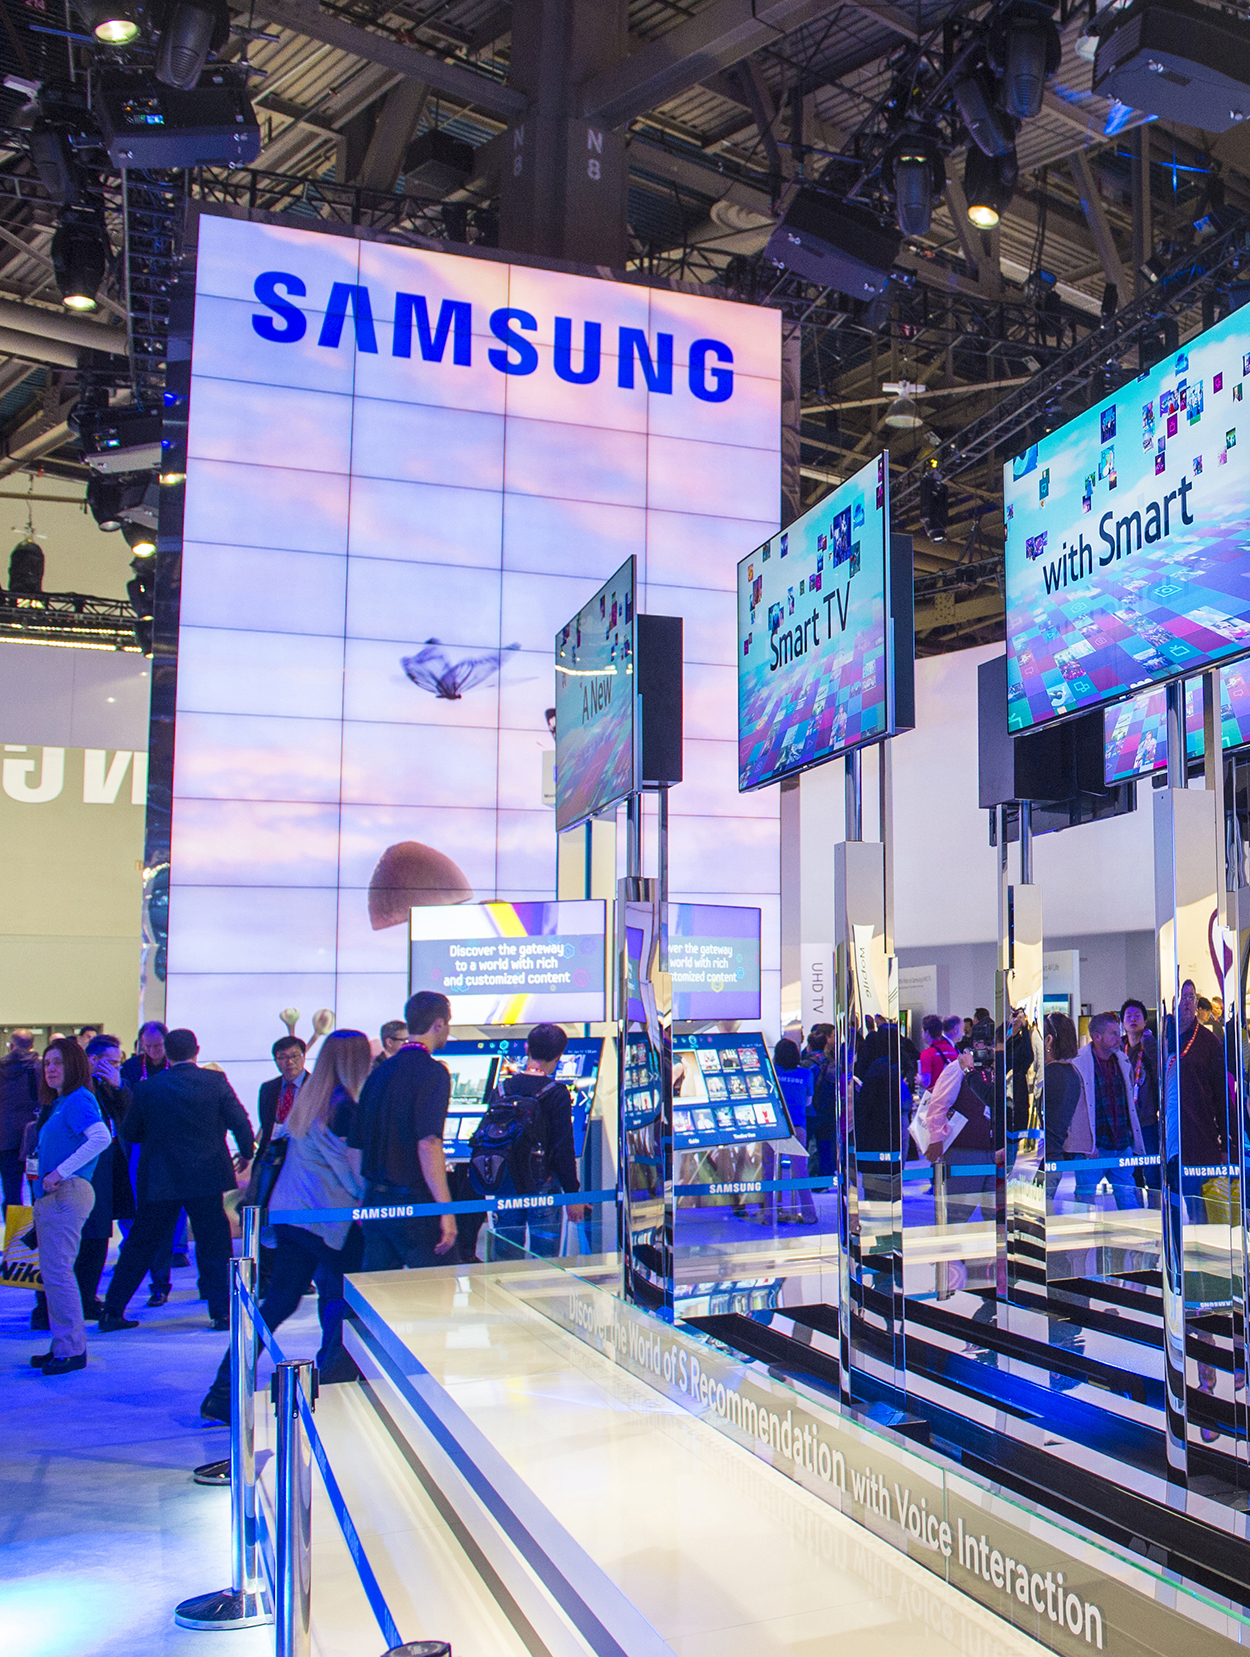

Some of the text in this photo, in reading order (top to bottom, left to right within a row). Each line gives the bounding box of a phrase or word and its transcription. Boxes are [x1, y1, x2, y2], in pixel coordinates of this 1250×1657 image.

[252, 270, 735, 404] SAMSUNG
[1042, 475, 1195, 596] with Smart
[769, 580, 851, 673] Smart TV
[591, 673, 613, 718] New
[449, 943, 565, 958] Discover the gateway
[684, 942, 699, 954] the
[701, 944, 733, 958] gateway
[455, 956, 558, 972] to a world with rich
[694, 957, 711, 969] with
[713, 957, 729, 969] rich
[443, 971, 571, 987] and customized content
[672, 971, 738, 983] stomized content
[811, 962, 824, 1014] UHD TV
[1119, 1156, 1161, 1167] SAMSUNG
[709, 1182, 762, 1194] SAMSUNG
[497, 1195, 554, 1210] SAMSUNG
[352, 1206, 414, 1220] SAMSUNG
[628, 1321, 662, 1376] World
[663, 1345, 678, 1385] of
[679, 1350, 689, 1392] S
[690, 1355, 846, 1492] Recommendation
[851, 1467, 891, 1521] with
[894, 1483, 952, 1556] Voice
[957, 1517, 1104, 1650] Interaction
